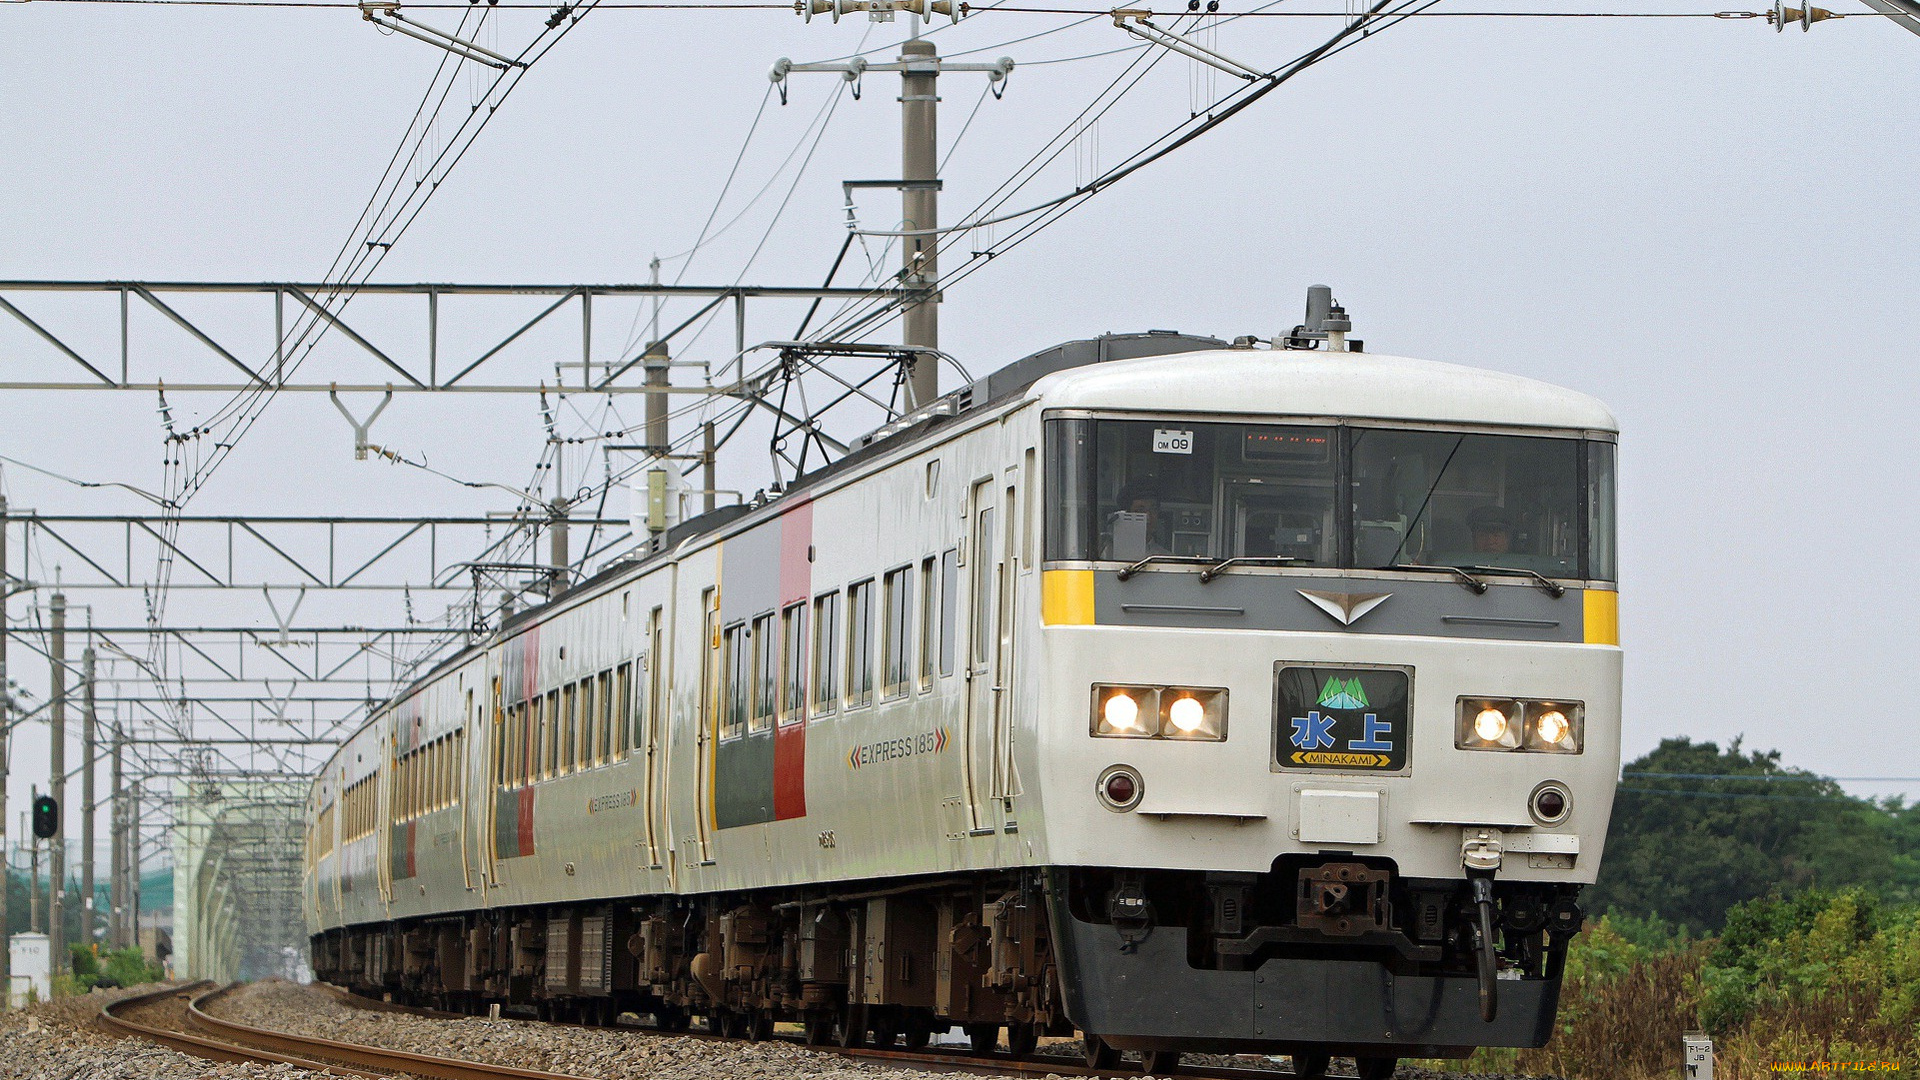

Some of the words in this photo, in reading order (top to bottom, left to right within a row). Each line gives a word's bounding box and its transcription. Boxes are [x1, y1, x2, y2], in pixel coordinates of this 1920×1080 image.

[1157, 441, 1169, 449] OM
[1171, 438, 1188, 450] 09
[861, 736, 912, 764] EXPRESS
[914, 731, 935, 755] 185
[1308, 753, 1372, 765] MINAKAMI
